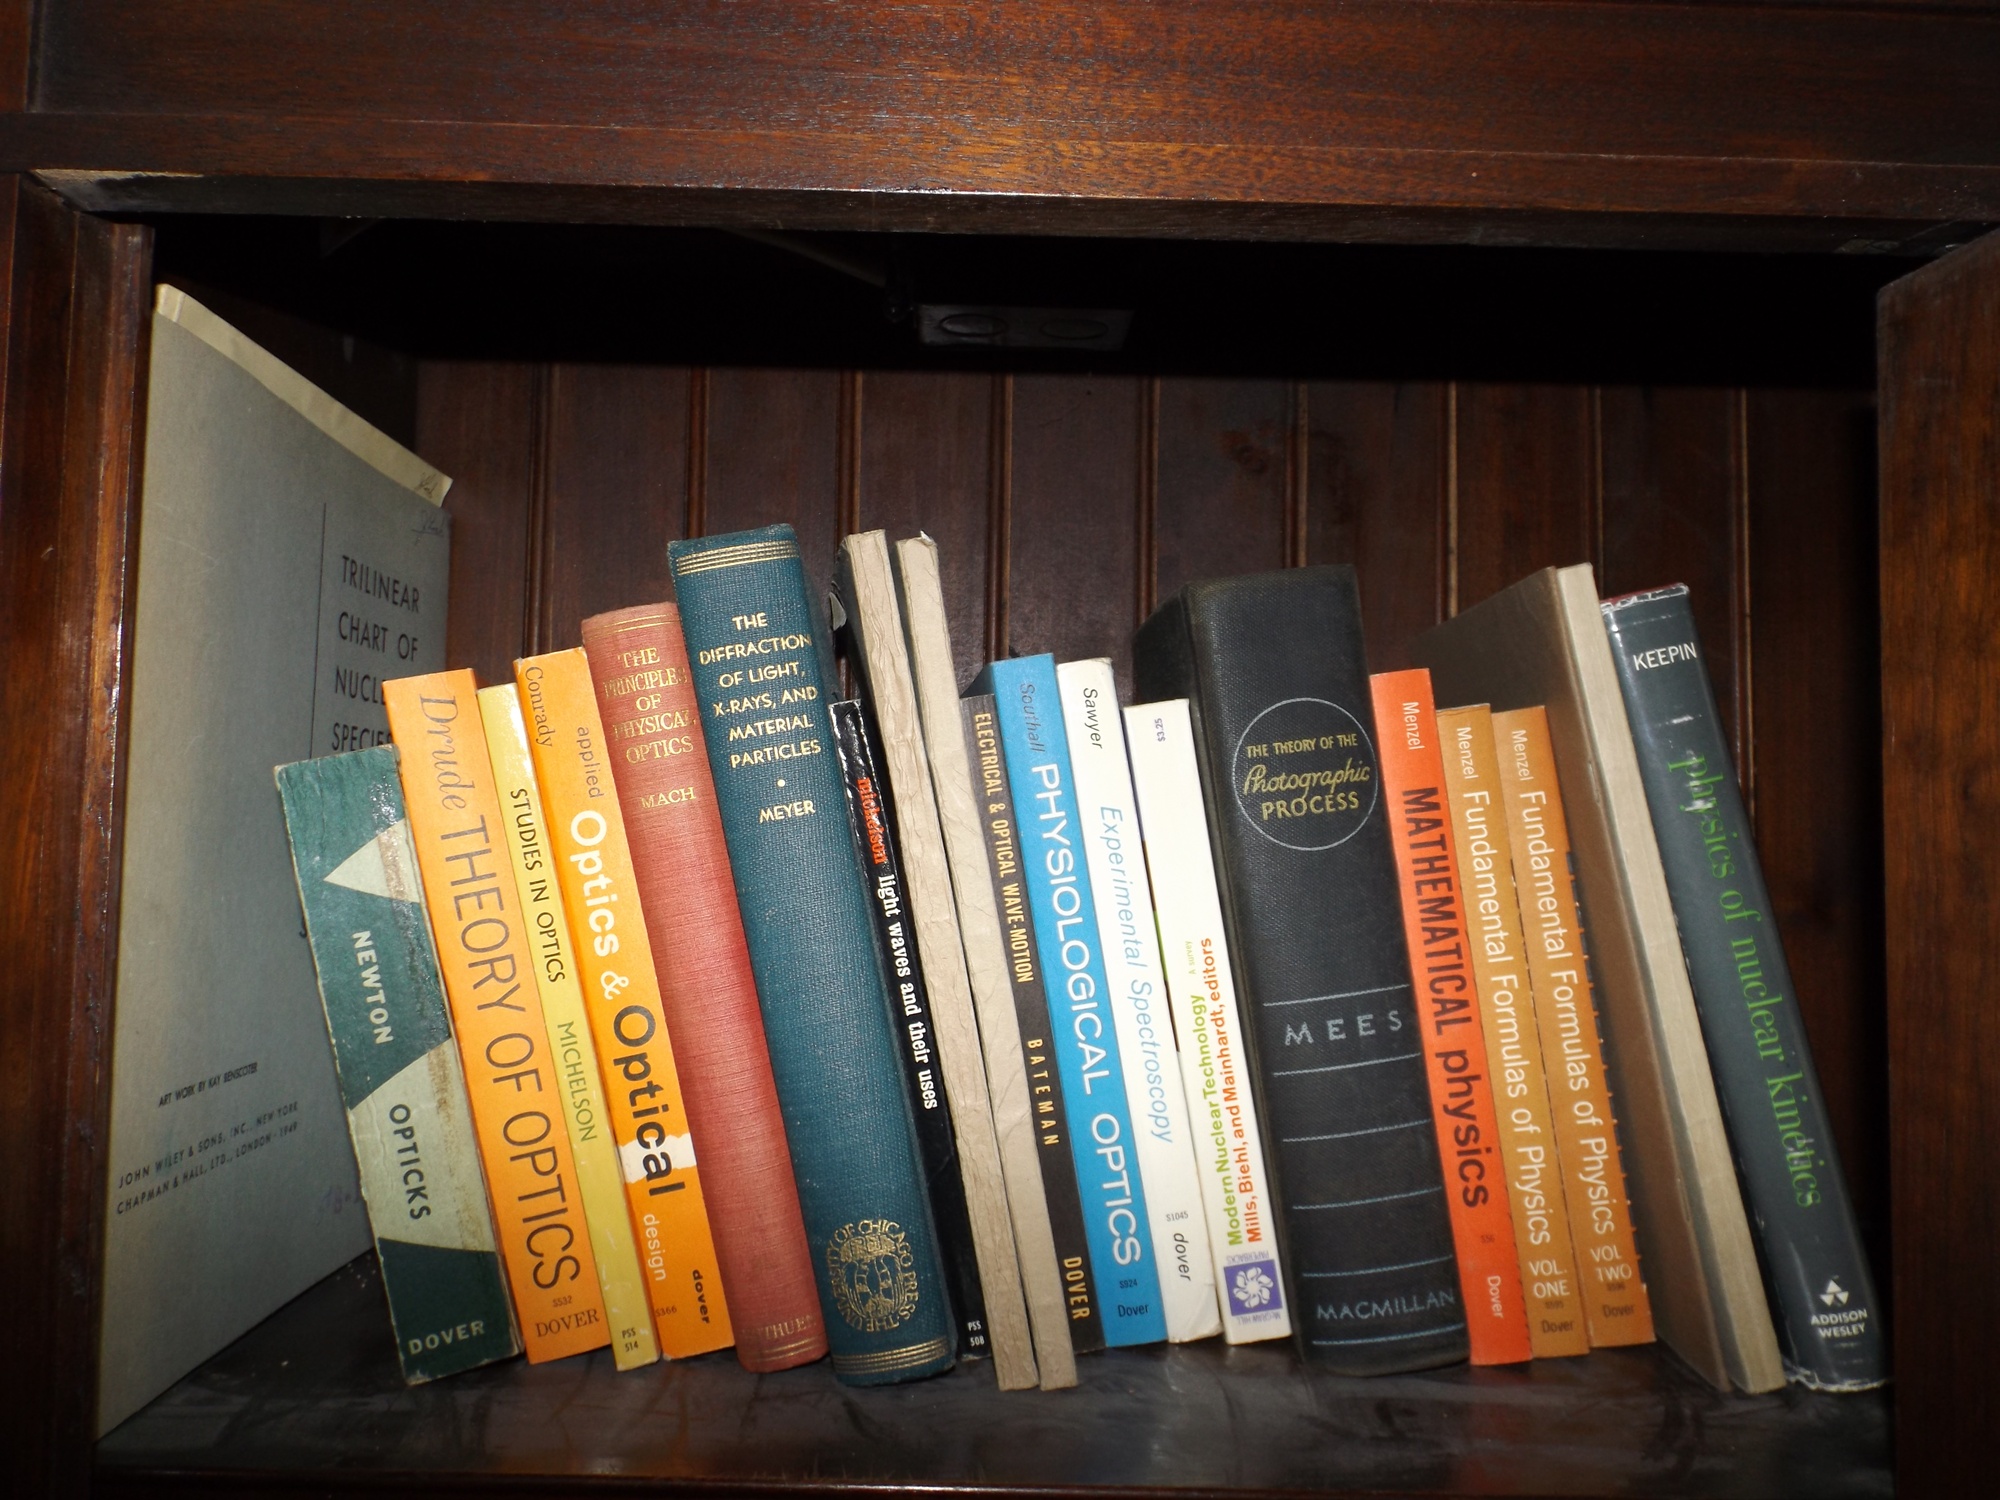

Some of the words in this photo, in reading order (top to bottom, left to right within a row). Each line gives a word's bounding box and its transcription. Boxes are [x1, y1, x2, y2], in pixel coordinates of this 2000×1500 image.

[341, 555, 420, 613] TRILINEAR
[338, 611, 388, 653] CHART
[397, 633, 418, 661] OF
[732, 612, 768, 631] THE
[618, 648, 660, 669] THE
[699, 633, 813, 666] DIFFRACTION
[719, 670, 744, 688] OF
[748, 661, 806, 684] LIGHT,
[1633, 641, 1698, 672] KEEPIN
[525, 666, 556, 747] Conrady
[604, 666, 688, 699] PRINCIPLES
[636, 693, 662, 712] OF
[712, 693, 777, 718] X-RAYS,
[781, 686, 818, 705] AND
[613, 709, 697, 741] PHYSICAL
[728, 714, 814, 742] MATERIAL
[1019, 683, 1046, 754] Southall
[1153, 717, 1166, 743] $3.25
[1402, 702, 1425, 751] Menzel
[419, 693, 476, 811] Drude
[577, 726, 604, 799] applied
[626, 735, 694, 765] OPTICS
[730, 739, 821, 769] PARTICLES
[974, 712, 1003, 797] ELECTRICAL
[1246, 744, 1269, 758] THE
[1273, 738, 1317, 756] THEORY
[1320, 735, 1334, 749] OF
[1336, 733, 1358, 747] THE
[1456, 726, 1479, 780] Menzel
[1512, 729, 1534, 781] Menzel
[641, 787, 697, 809] MACH
[1243, 757, 1371, 801] Photographic
[510, 788, 543, 872] STUDIES
[758, 800, 816, 824] MEYER
[857, 777, 888, 865] michelson
[989, 801, 1006, 814] &
[1261, 791, 1359, 821] PROCESS
[1667, 755, 1739, 880] physics
[992, 818, 1016, 878] OPTICAL
[529, 878, 550, 904] IN
[570, 810, 620, 957] Optics
[877, 874, 902, 918] light
[1463, 789, 1514, 964] Fundamental
[1519, 790, 1574, 960] Fundamental
[440, 814, 526, 1012] THEORY
[1031, 762, 1111, 1096] PHYSIOLOGICAL
[1082, 687, 1103, 749] Sawyer
[1100, 805, 1148, 969] Experimental
[1126, 977, 1174, 1144] Spectroscopy
[1402, 786, 1473, 1036] MATHEMATICAL
[1719, 888, 1763, 924] of
[536, 911, 565, 983] OPTICS
[888, 922, 912, 978] waves
[1002, 882, 1034, 984] WAVE-MOTION
[1185, 940, 1196, 967] survey
[352, 930, 395, 1046] NEWTON
[600, 970, 630, 1001] &
[1201, 937, 1221, 1001] editors
[900, 982, 922, 1017] and
[1731, 934, 1786, 1063] nuclear
[908, 1020, 930, 1065] their
[1190, 994, 1219, 1099] Technology
[1285, 1010, 1403, 1046] MEES
[1490, 973, 1531, 1099] Formulas
[1551, 969, 1592, 1092] Formulas
[485, 1032, 543, 1093] OF
[1210, 1004, 1238, 1103] Mainhardt,
[158, 1092, 172, 1107] ART
[175, 1084, 195, 1101] WORK
[198, 1080, 206, 1093] BY
[208, 1074, 222, 1089] KAY
[557, 1020, 598, 1143] MICHELSON
[612, 1004, 686, 1197] Optical
[918, 1069, 938, 1110] uses
[1027, 1038, 1060, 1146] BATEMAN
[1208, 1100, 1232, 1173] Nuclear
[1226, 1104, 1244, 1138] and
[1435, 1049, 1491, 1209] physics
[1511, 1107, 1541, 1134] of
[1573, 1100, 1604, 1126] of
[118, 1165, 150, 1189] JOHN
[155, 1149, 184, 1172] WILEY
[188, 1145, 194, 1158] &
[198, 1132, 226, 1153] SONS,
[256, 1110, 275, 1127] NEW
[277, 1101, 299, 1119] YORK
[389, 1103, 432, 1220] OPTICKS
[1765, 1071, 1826, 1209] kinetics
[116, 1180, 170, 1214] CHAPMAN
[172, 1176, 179, 1189] &
[182, 1163, 208, 1185] HALL,
[236, 1133, 272, 1158] LONDON
[1091, 1112, 1142, 1267] OPTICS
[1233, 1141, 1255, 1193] Biehl,
[1579, 1137, 1620, 1236] Physics
[502, 1110, 581, 1290] OPTICS
[1217, 1175, 1243, 1246] Modern
[1244, 1194, 1263, 1243] Mills,
[1515, 1145, 1554, 1246] Physics
[643, 1213, 667, 1281] design
[834, 1223, 855, 1243] OF
[858, 1220, 914, 1267] CHICAGO
[898, 1271, 919, 1320] PRESS
[1173, 1231, 1192, 1282] dover
[1528, 1259, 1568, 1277] VOL.
[1590, 1244, 1622, 1263] VOL
[692, 1269, 710, 1325] dover
[1063, 1256, 1091, 1321] DOVER
[1487, 1275, 1504, 1319] Dover
[1533, 1279, 1570, 1299] ONE
[1595, 1263, 1633, 1282] TWO
[535, 1308, 600, 1338] DOVER
[967, 1319, 982, 1332] PSS
[1117, 1302, 1150, 1318] Dover
[1316, 1287, 1456, 1321] MACMILLAN
[1541, 1319, 1573, 1334] Dover
[1602, 1304, 1635, 1319] Dover
[1810, 1307, 1869, 1327] ADDISON
[408, 1320, 485, 1356] DOVER
[622, 1326, 637, 1339] PSS
[625, 1341, 639, 1352] 514
[1818, 1322, 1866, 1339] WESLEY
